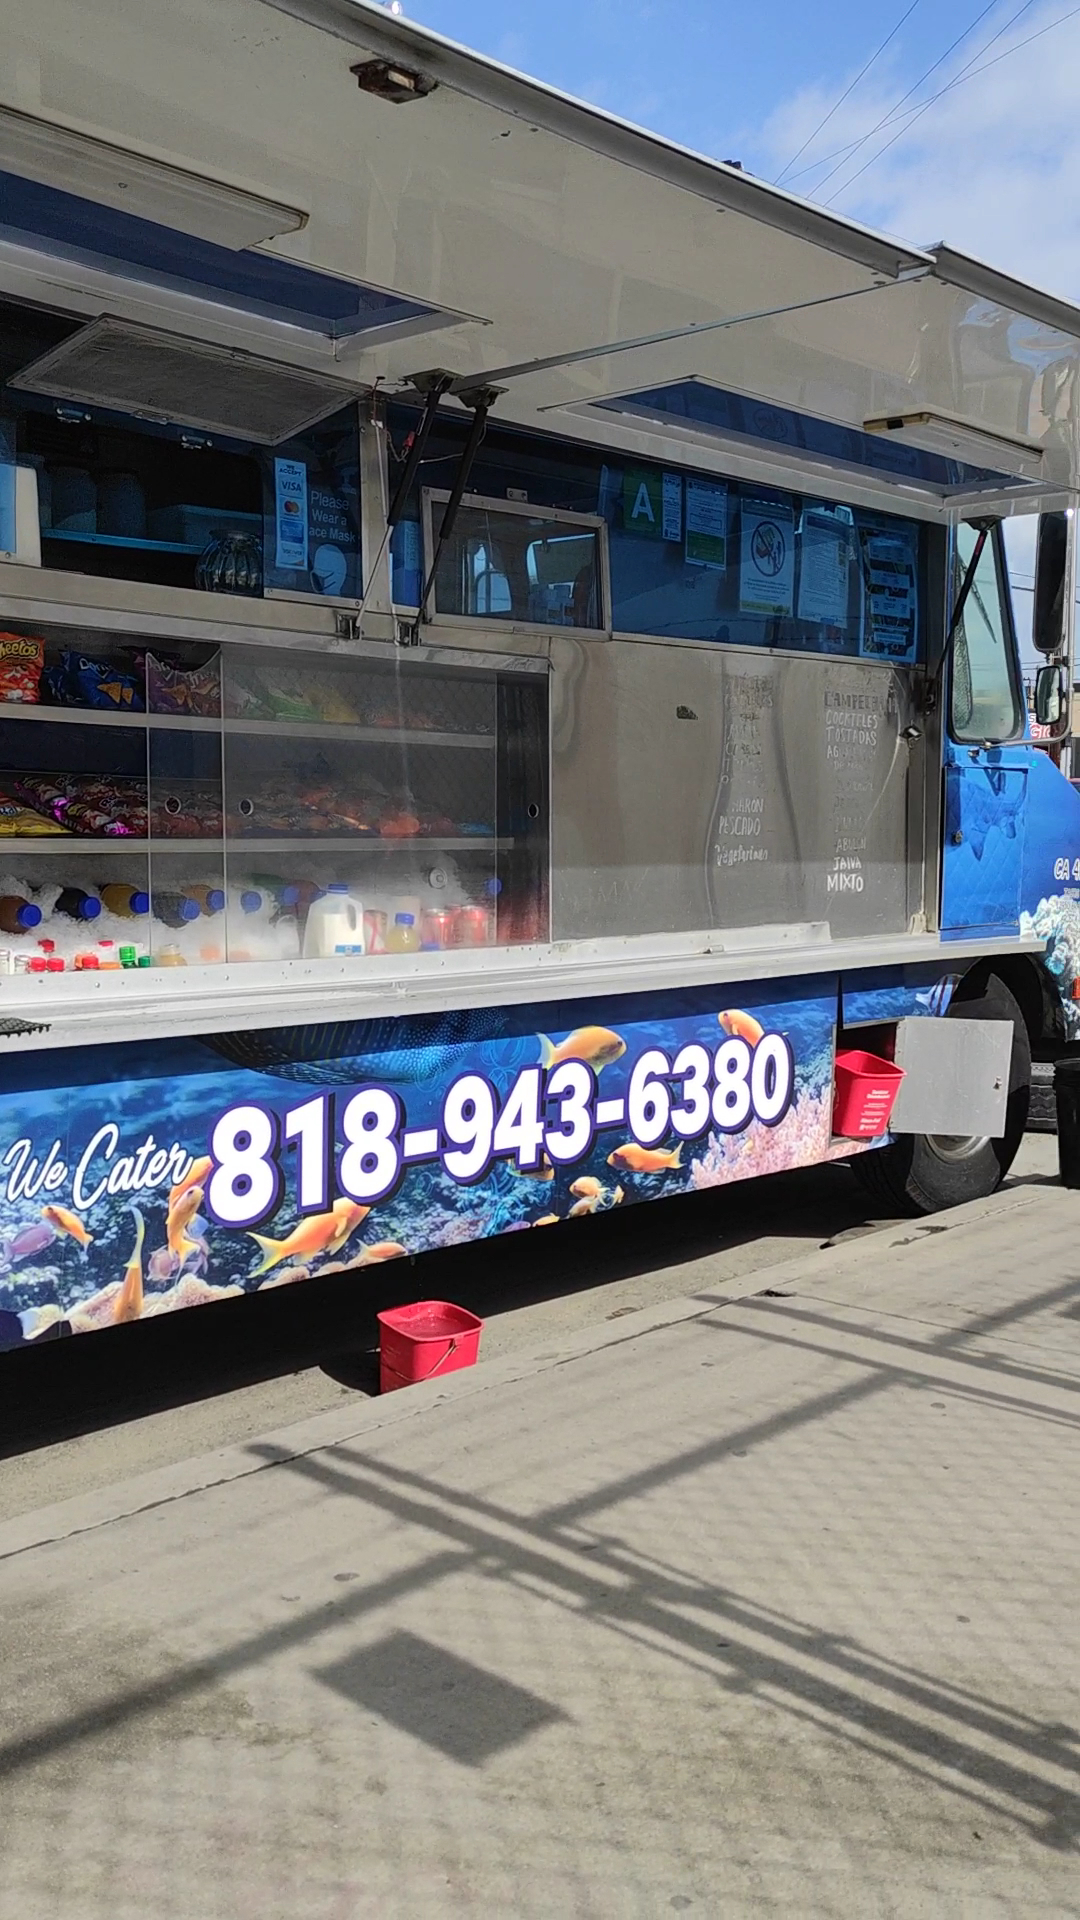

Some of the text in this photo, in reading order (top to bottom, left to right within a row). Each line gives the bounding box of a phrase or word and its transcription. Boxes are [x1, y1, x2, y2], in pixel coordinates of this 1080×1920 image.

[280, 468, 302, 476] ACCEPT
[281, 481, 302, 492] VISA
[311, 490, 349, 511] Please
[631, 483, 655, 522] A
[312, 509, 339, 524] Wear
[341, 515, 347, 526] a
[309, 527, 327, 538] ace
[329, 528, 356, 543] Mask
[0, 640, 38, 659] heetos
[826, 726, 877, 746] TOSTADAS
[719, 816, 761, 836] PESCADO
[833, 856, 862, 871] JAIVA
[1054, 857, 1070, 880] CA
[827, 873, 864, 892] MIXTO
[206, 1031, 793, 1226] 818-943-6380
[3, 1122, 194, 1211] We Cater
